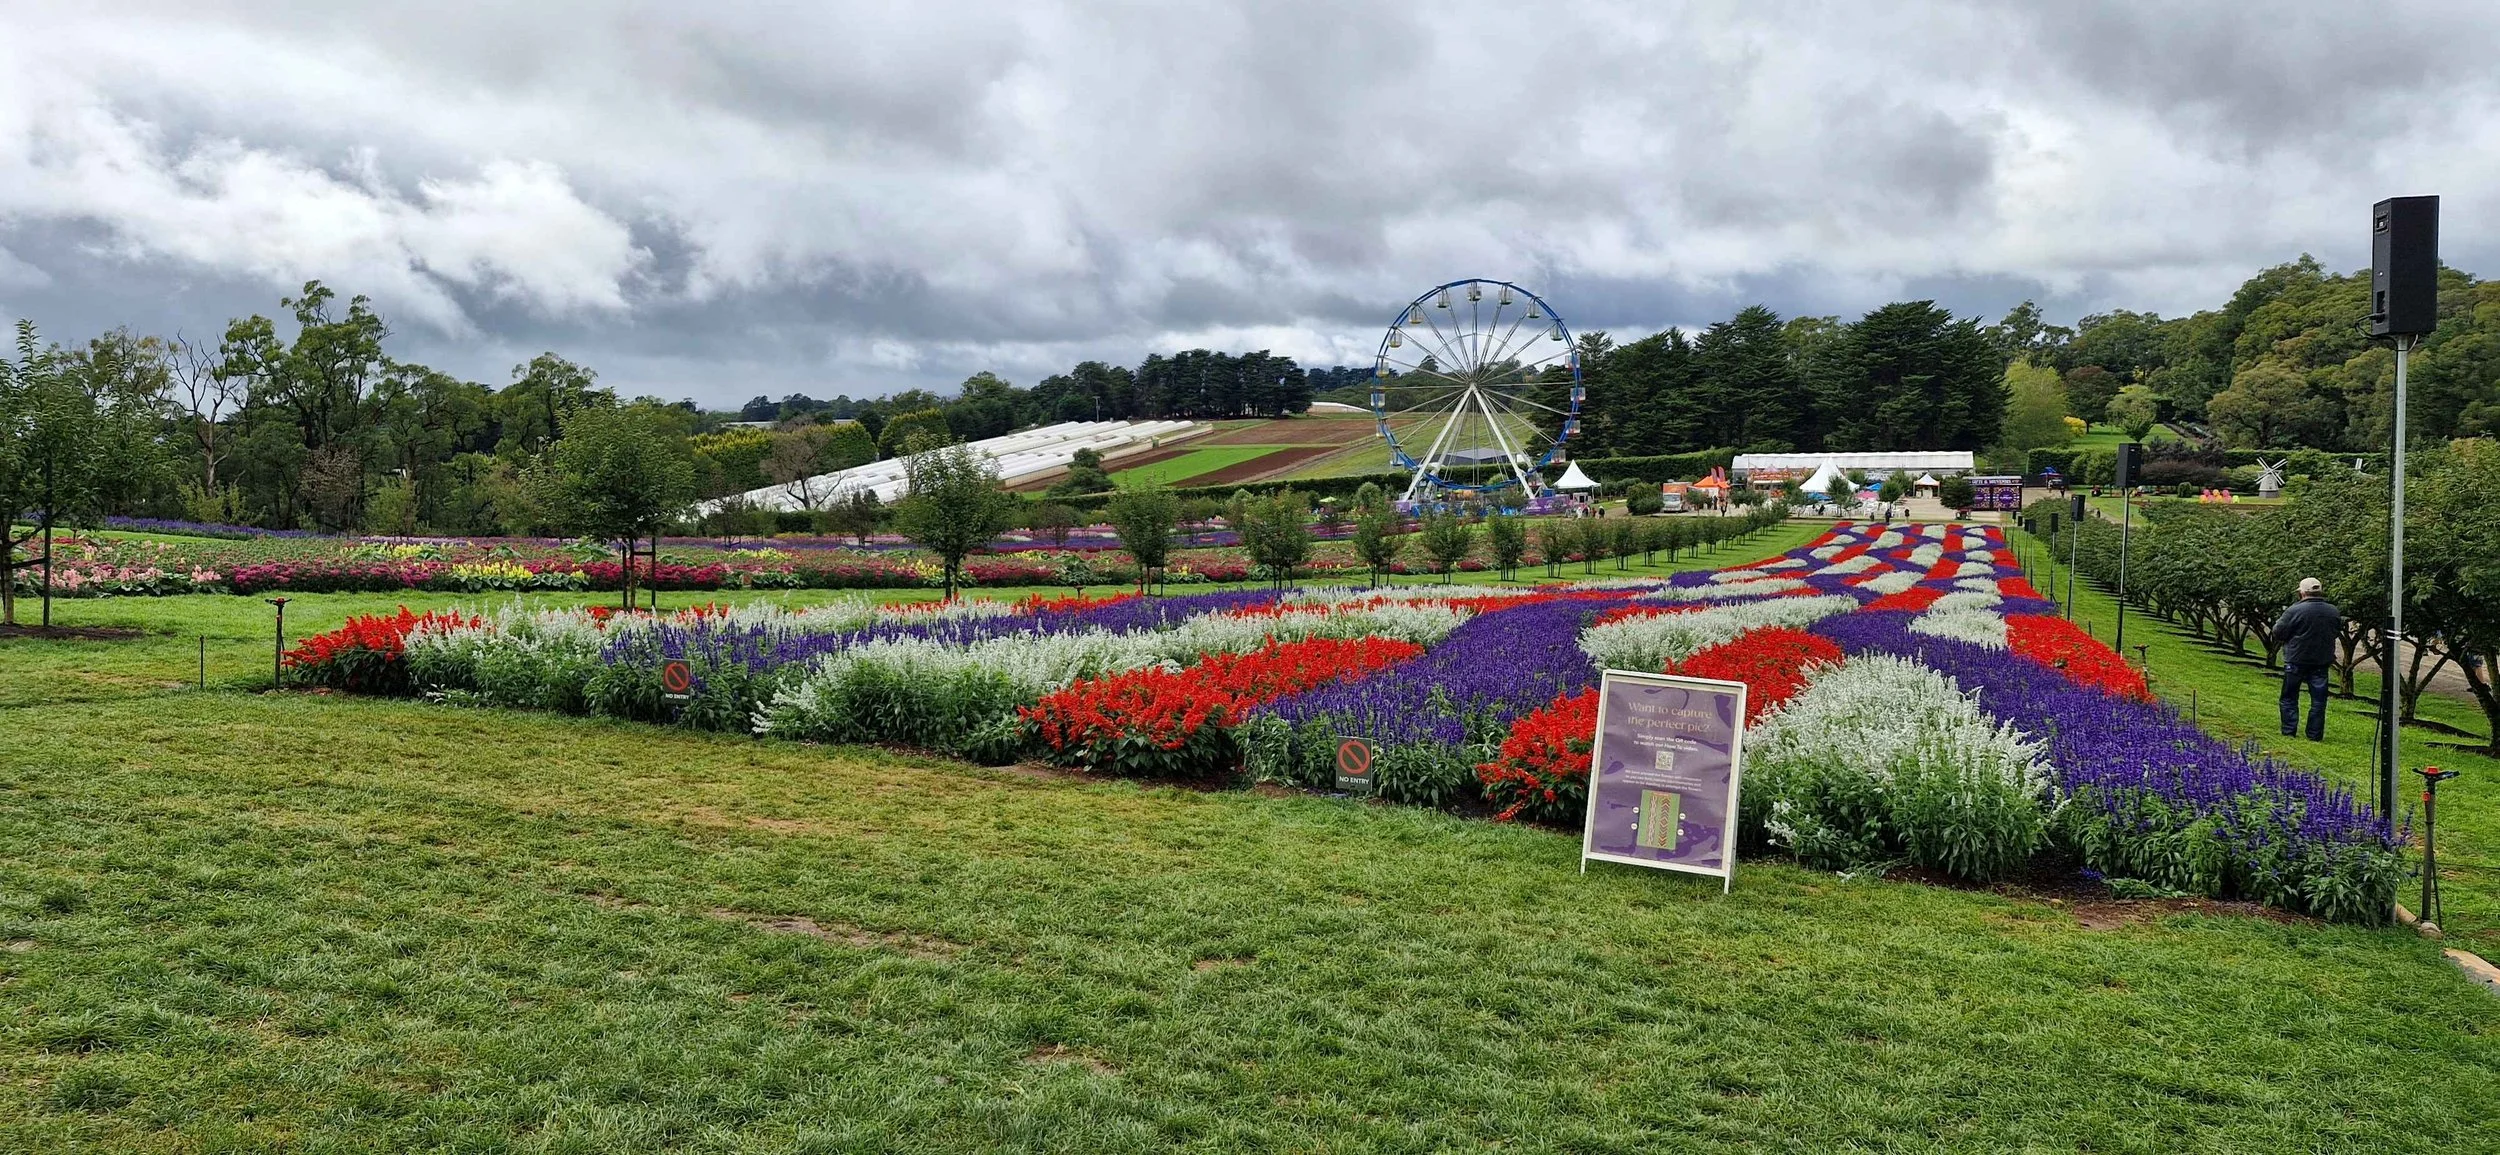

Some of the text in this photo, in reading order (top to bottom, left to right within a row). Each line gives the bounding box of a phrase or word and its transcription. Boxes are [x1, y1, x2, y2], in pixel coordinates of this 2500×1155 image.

[1628, 702, 1712, 719] Want to capture
[1628, 716, 1711, 733] the perfect pic?
